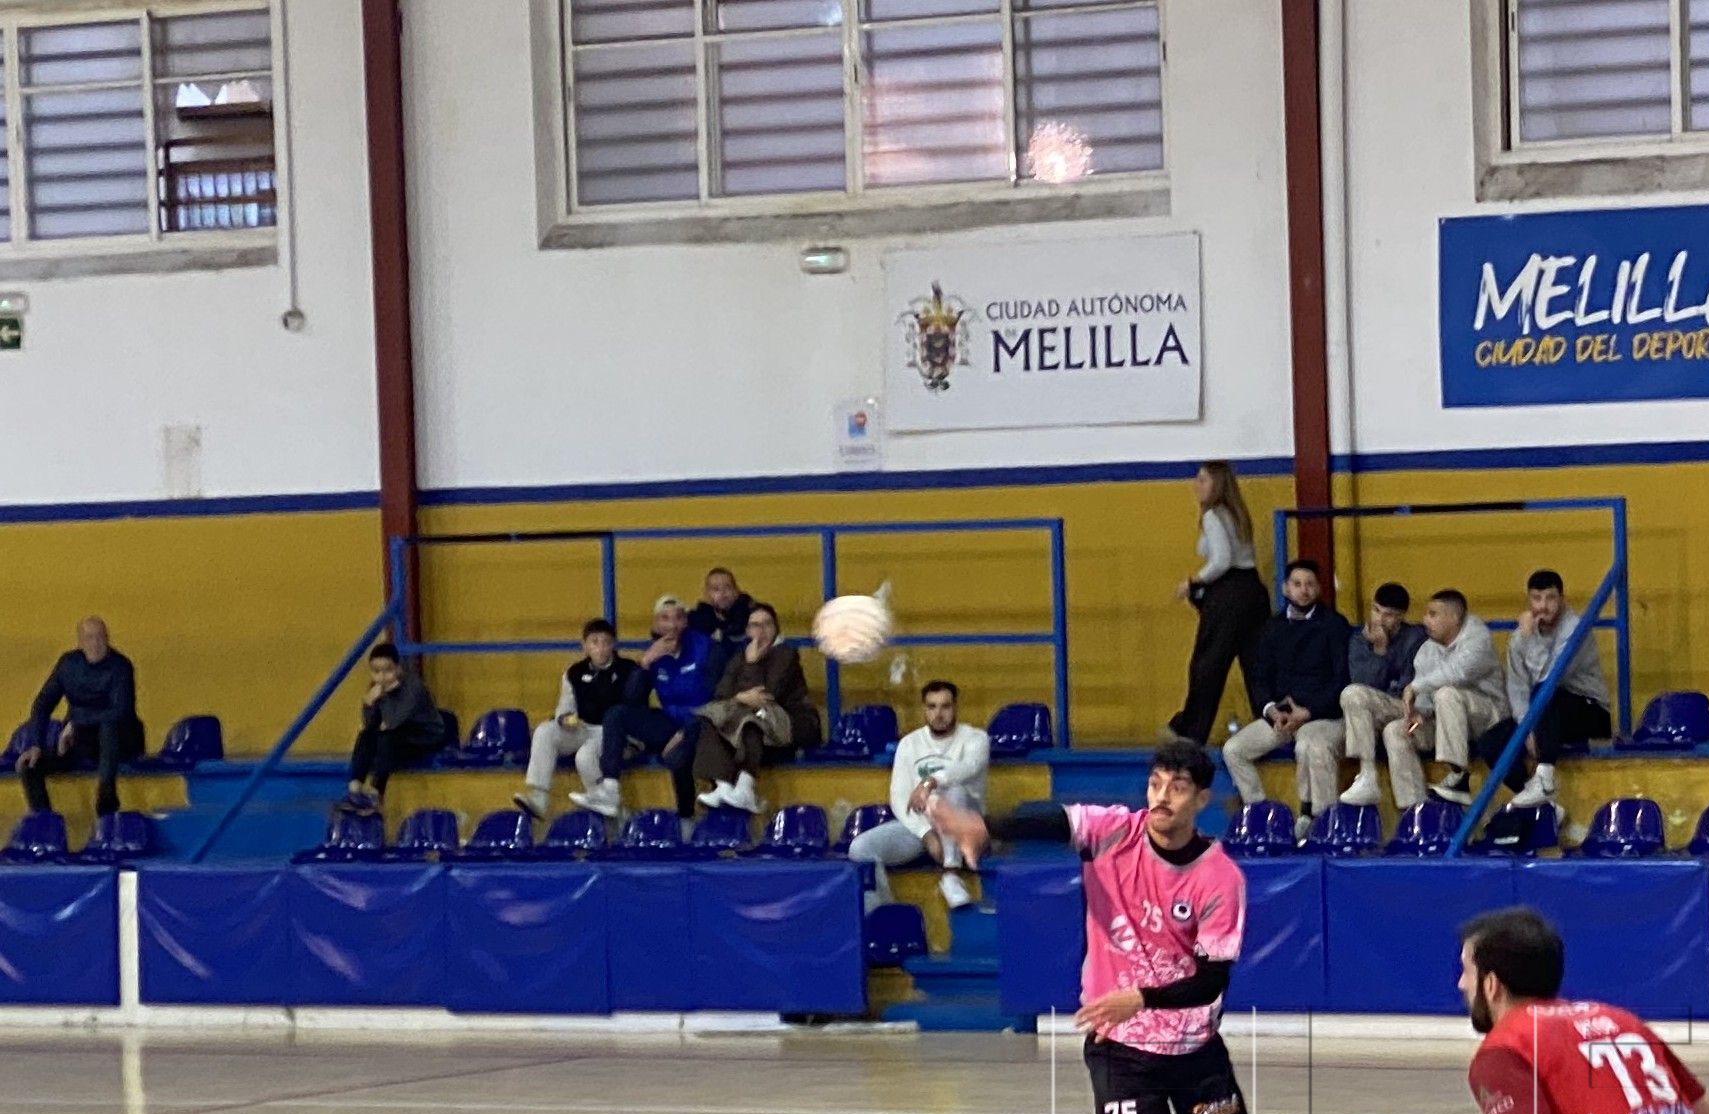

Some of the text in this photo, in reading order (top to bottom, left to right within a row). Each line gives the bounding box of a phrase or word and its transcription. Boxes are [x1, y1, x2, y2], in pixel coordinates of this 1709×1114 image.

[986, 293, 1187, 321] CIUDAD AUTÓNOMA
[991, 323, 1189, 373] MELILLA
[1474, 338, 1567, 368] CIUDAD
[1576, 334, 1622, 363] DEL
[1578, 1032, 1678, 1109] 73
